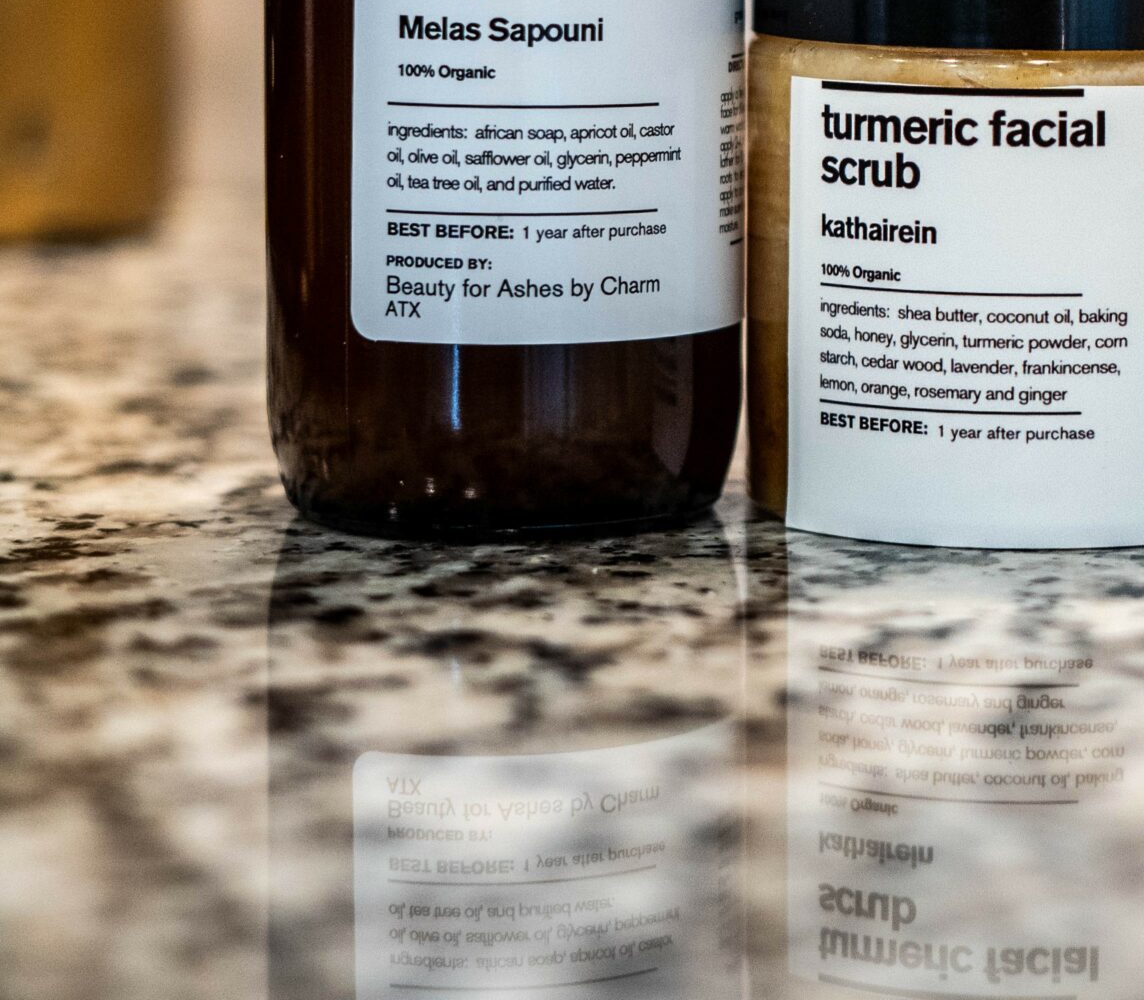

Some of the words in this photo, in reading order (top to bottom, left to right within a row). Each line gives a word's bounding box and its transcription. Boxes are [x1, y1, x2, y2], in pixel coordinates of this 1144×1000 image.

[399, 15, 482, 41] Melas
[488, 18, 603, 47] Sapouni
[398, 64, 435, 77] 100%
[438, 65, 496, 81] Organic
[388, 122, 467, 142] ingredients:
[475, 125, 523, 140] african
[527, 126, 567, 143] soap,
[570, 124, 617, 143] apricot
[620, 123, 637, 140] oil,
[639, 123, 675, 138] castor
[821, 104, 978, 146] turmeric
[989, 109, 1106, 147] facial
[387, 148, 404, 165] oil,
[408, 149, 438, 164] olive
[442, 150, 461, 167] oil,
[465, 150, 531, 166] safflower
[534, 151, 553, 168] oil,
[557, 150, 612, 169] glycerin,
[615, 146, 681, 168] peppermint
[821, 152, 920, 189] scrub
[387, 173, 404, 190] oil,
[408, 175, 429, 190] tea
[432, 176, 460, 191] tree
[464, 176, 482, 193] oil,
[486, 176, 515, 192] and
[518, 175, 571, 195] purified
[574, 176, 615, 191] water.
[388, 222, 431, 237] BEST
[435, 224, 514, 239] BEFORE:
[522, 226, 529, 239] 1
[536, 226, 568, 243] year
[572, 224, 605, 239] after
[609, 222, 666, 241] purchase
[821, 213, 937, 244] kathairein
[386, 255, 463, 270] PRODUCED
[468, 257, 492, 270] BY:
[821, 264, 850, 278] 100%
[853, 266, 901, 282] Organic
[386, 275, 455, 302] Beauty
[462, 278, 491, 297] for
[497, 278, 564, 298] Ashes
[571, 278, 594, 302] by
[600, 276, 660, 296] Charm
[385, 300, 421, 319] ATX
[820, 298, 890, 318] ingredients:
[898, 305, 931, 321] shea
[936, 307, 982, 324] butter,
[987, 310, 1049, 324] coconut
[1054, 309, 1074, 325] oil,
[1079, 308, 1127, 326] baking
[820, 325, 850, 342] soda,
[854, 327, 896, 348] honey,
[900, 331, 958, 350] glycerin,
[963, 335, 1024, 349] turmeric
[1028, 335, 1090, 353] powder,
[1095, 336, 1128, 349] corn
[820, 350, 858, 368] starch,
[862, 354, 899, 369] cedar
[903, 358, 946, 375] wood,
[951, 358, 1017, 376] lavender,
[1023, 360, 1120, 376] frankincense,
[820, 374, 857, 394] lemon,
[861, 383, 910, 400] orange,
[914, 386, 981, 404] rosemary
[986, 387, 1014, 401] and
[1019, 387, 1067, 405] ginger
[820, 412, 855, 428] BEST
[859, 416, 927, 435] BEFORE:
[938, 425, 944, 437] 1
[951, 427, 982, 442] year
[987, 426, 1021, 440] after
[1026, 426, 1095, 444] purchase
